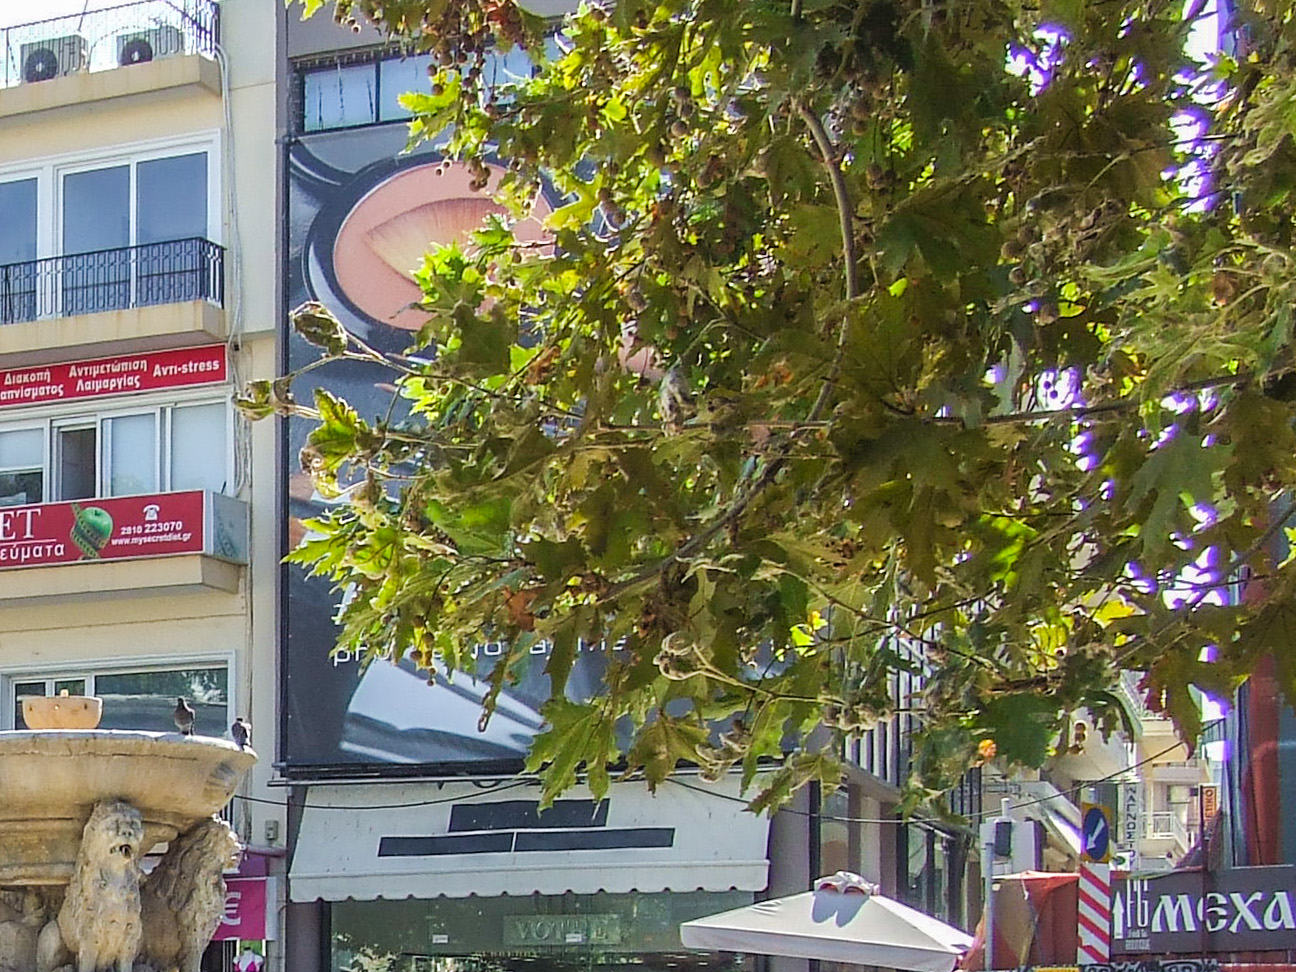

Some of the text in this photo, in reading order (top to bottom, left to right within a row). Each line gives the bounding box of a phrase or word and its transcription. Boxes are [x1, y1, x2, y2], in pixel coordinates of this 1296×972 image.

[4, 368, 51, 386] Διακοπή
[68, 357, 148, 379] Αντιμετώπιση
[75, 373, 141, 393] Λαιμαργίας
[144, 521, 183, 533] 223070
